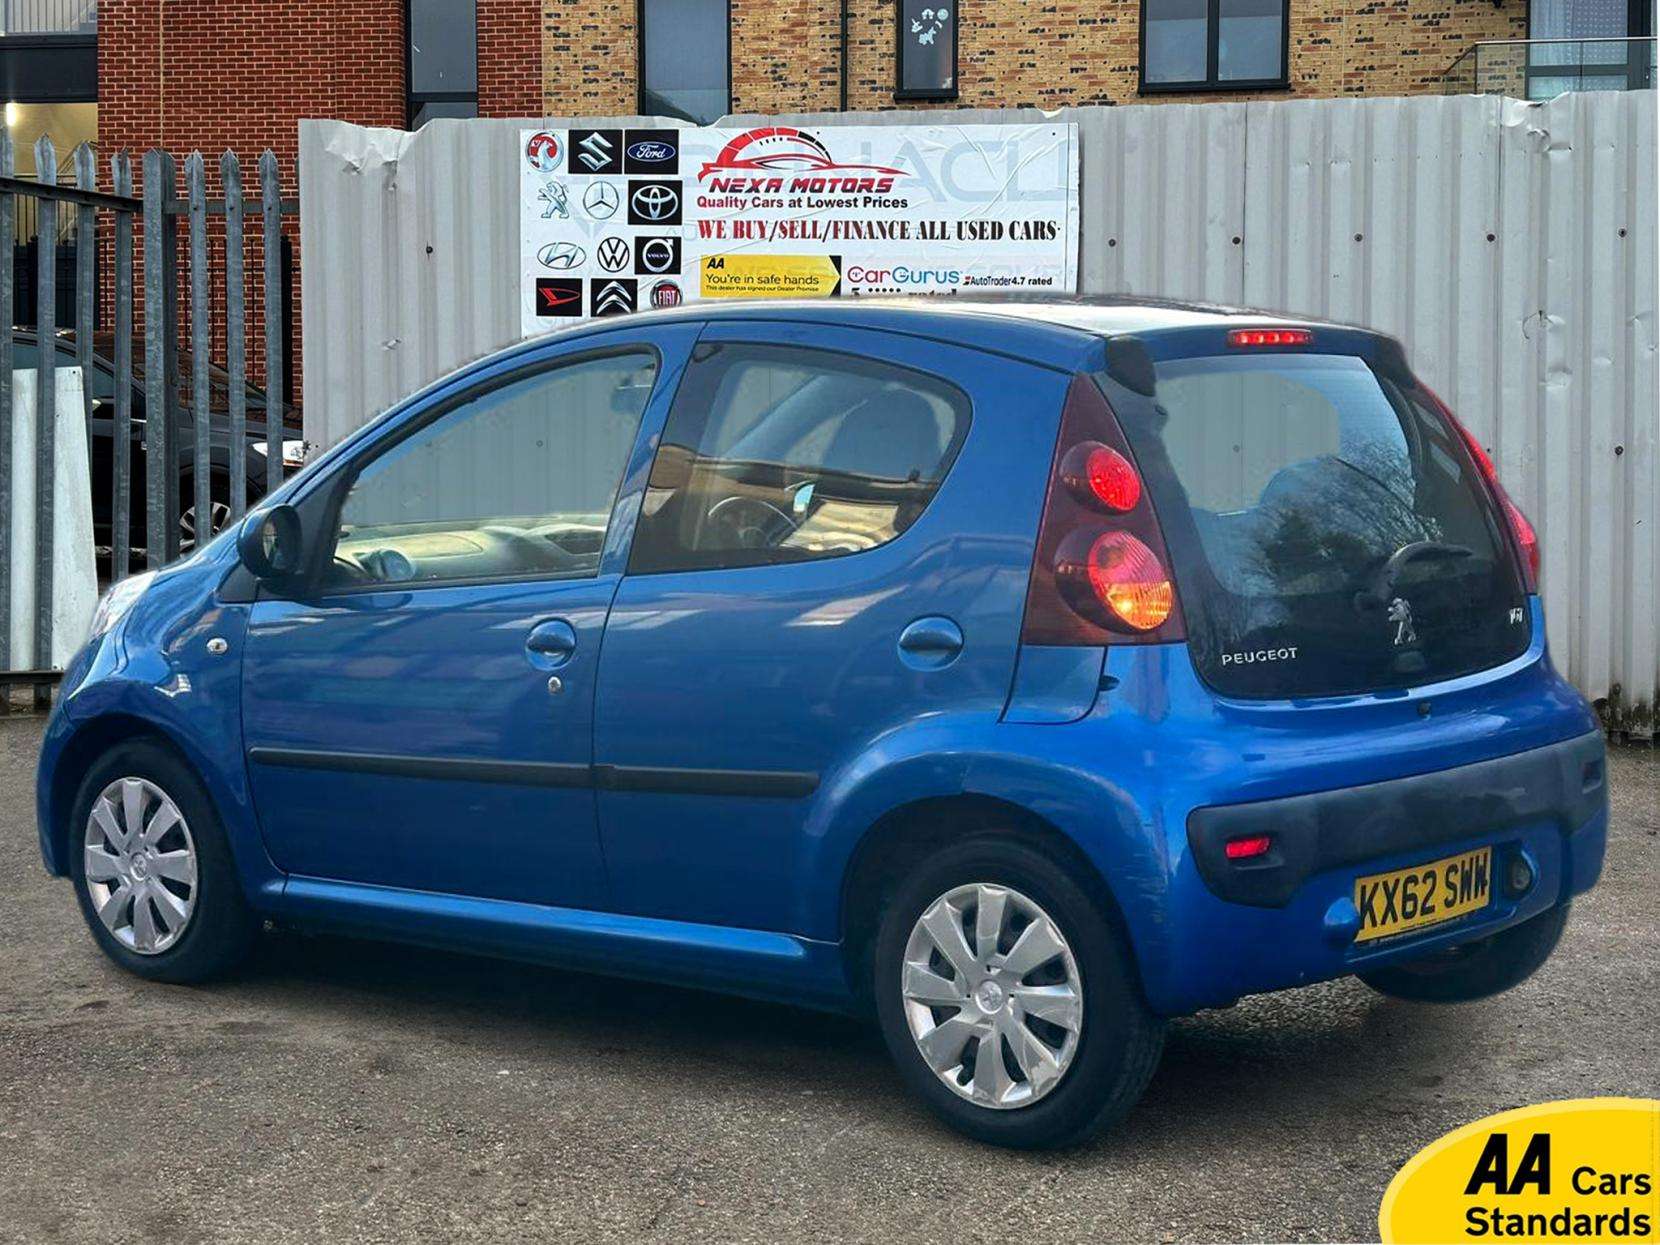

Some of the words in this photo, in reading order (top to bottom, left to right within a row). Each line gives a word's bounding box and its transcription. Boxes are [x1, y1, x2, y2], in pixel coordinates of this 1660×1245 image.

[636, 144, 666, 159] Ford
[709, 177, 783, 193] NEXA
[789, 177, 895, 193] MOTORS
[697, 196, 747, 210] Quality
[751, 196, 784, 208] Cars
[788, 197, 803, 208] at
[807, 196, 859, 208] Lowest
[863, 196, 908, 208] Prices
[697, 220, 727, 240] WE
[916, 220, 951, 240] ALL
[956, 220, 1004, 240] USED
[1008, 220, 1057, 240] CARS
[707, 257, 724, 269] AA
[706, 274, 741, 284] You're
[744, 275, 754, 284] in
[757, 274, 781, 284] safe
[784, 274, 819, 285] hands
[847, 265, 960, 284] CarGurus
[970, 276, 1011, 286] AutoTrader
[1028, 277, 1053, 286] rated
[658, 290, 676, 305] FIAT
[1221, 647, 1298, 665] PEUGEOT
[1360, 870, 1437, 929] KX62
